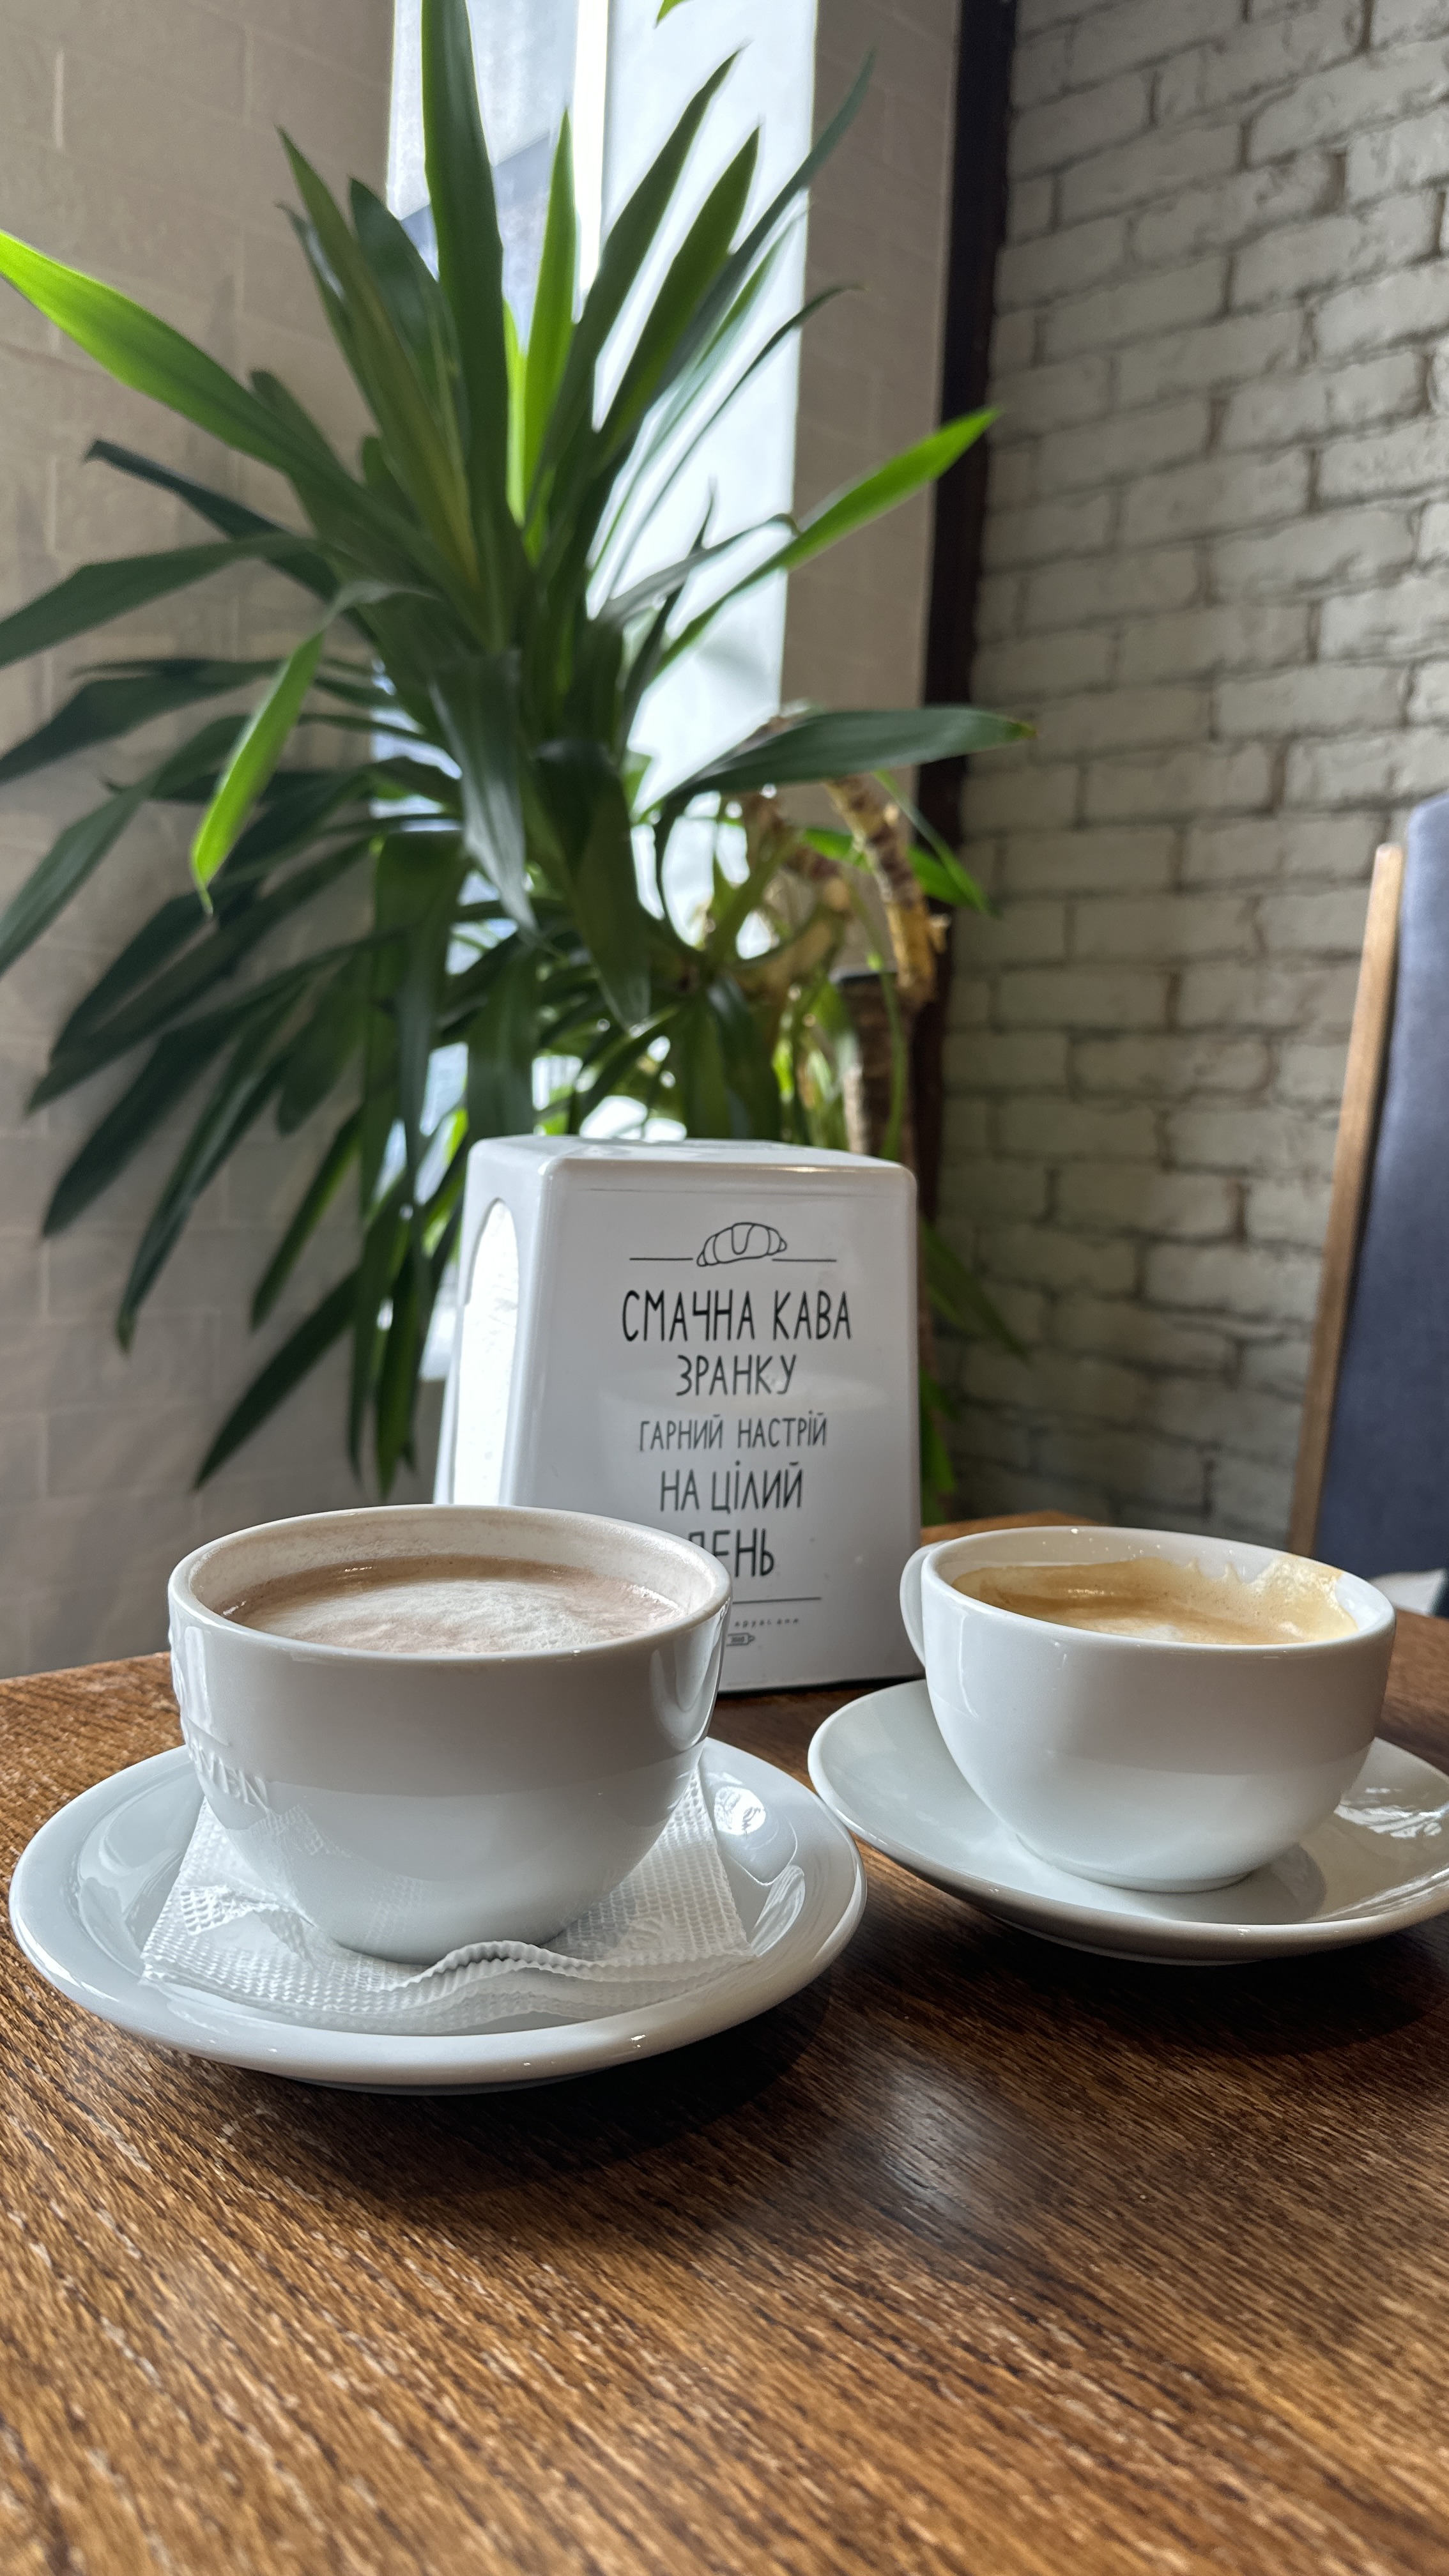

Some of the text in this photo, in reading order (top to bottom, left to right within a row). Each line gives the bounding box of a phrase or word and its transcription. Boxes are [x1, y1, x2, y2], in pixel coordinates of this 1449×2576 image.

[622, 1289, 851, 1342] СМАЧНА КАВА
[676, 1354, 796, 1396] ЗРАНКУ
[639, 1409, 827, 1452] ГАРНИЙ НАСТРІЙ
[660, 1460, 802, 1514] НА ЦІЛИЙ
